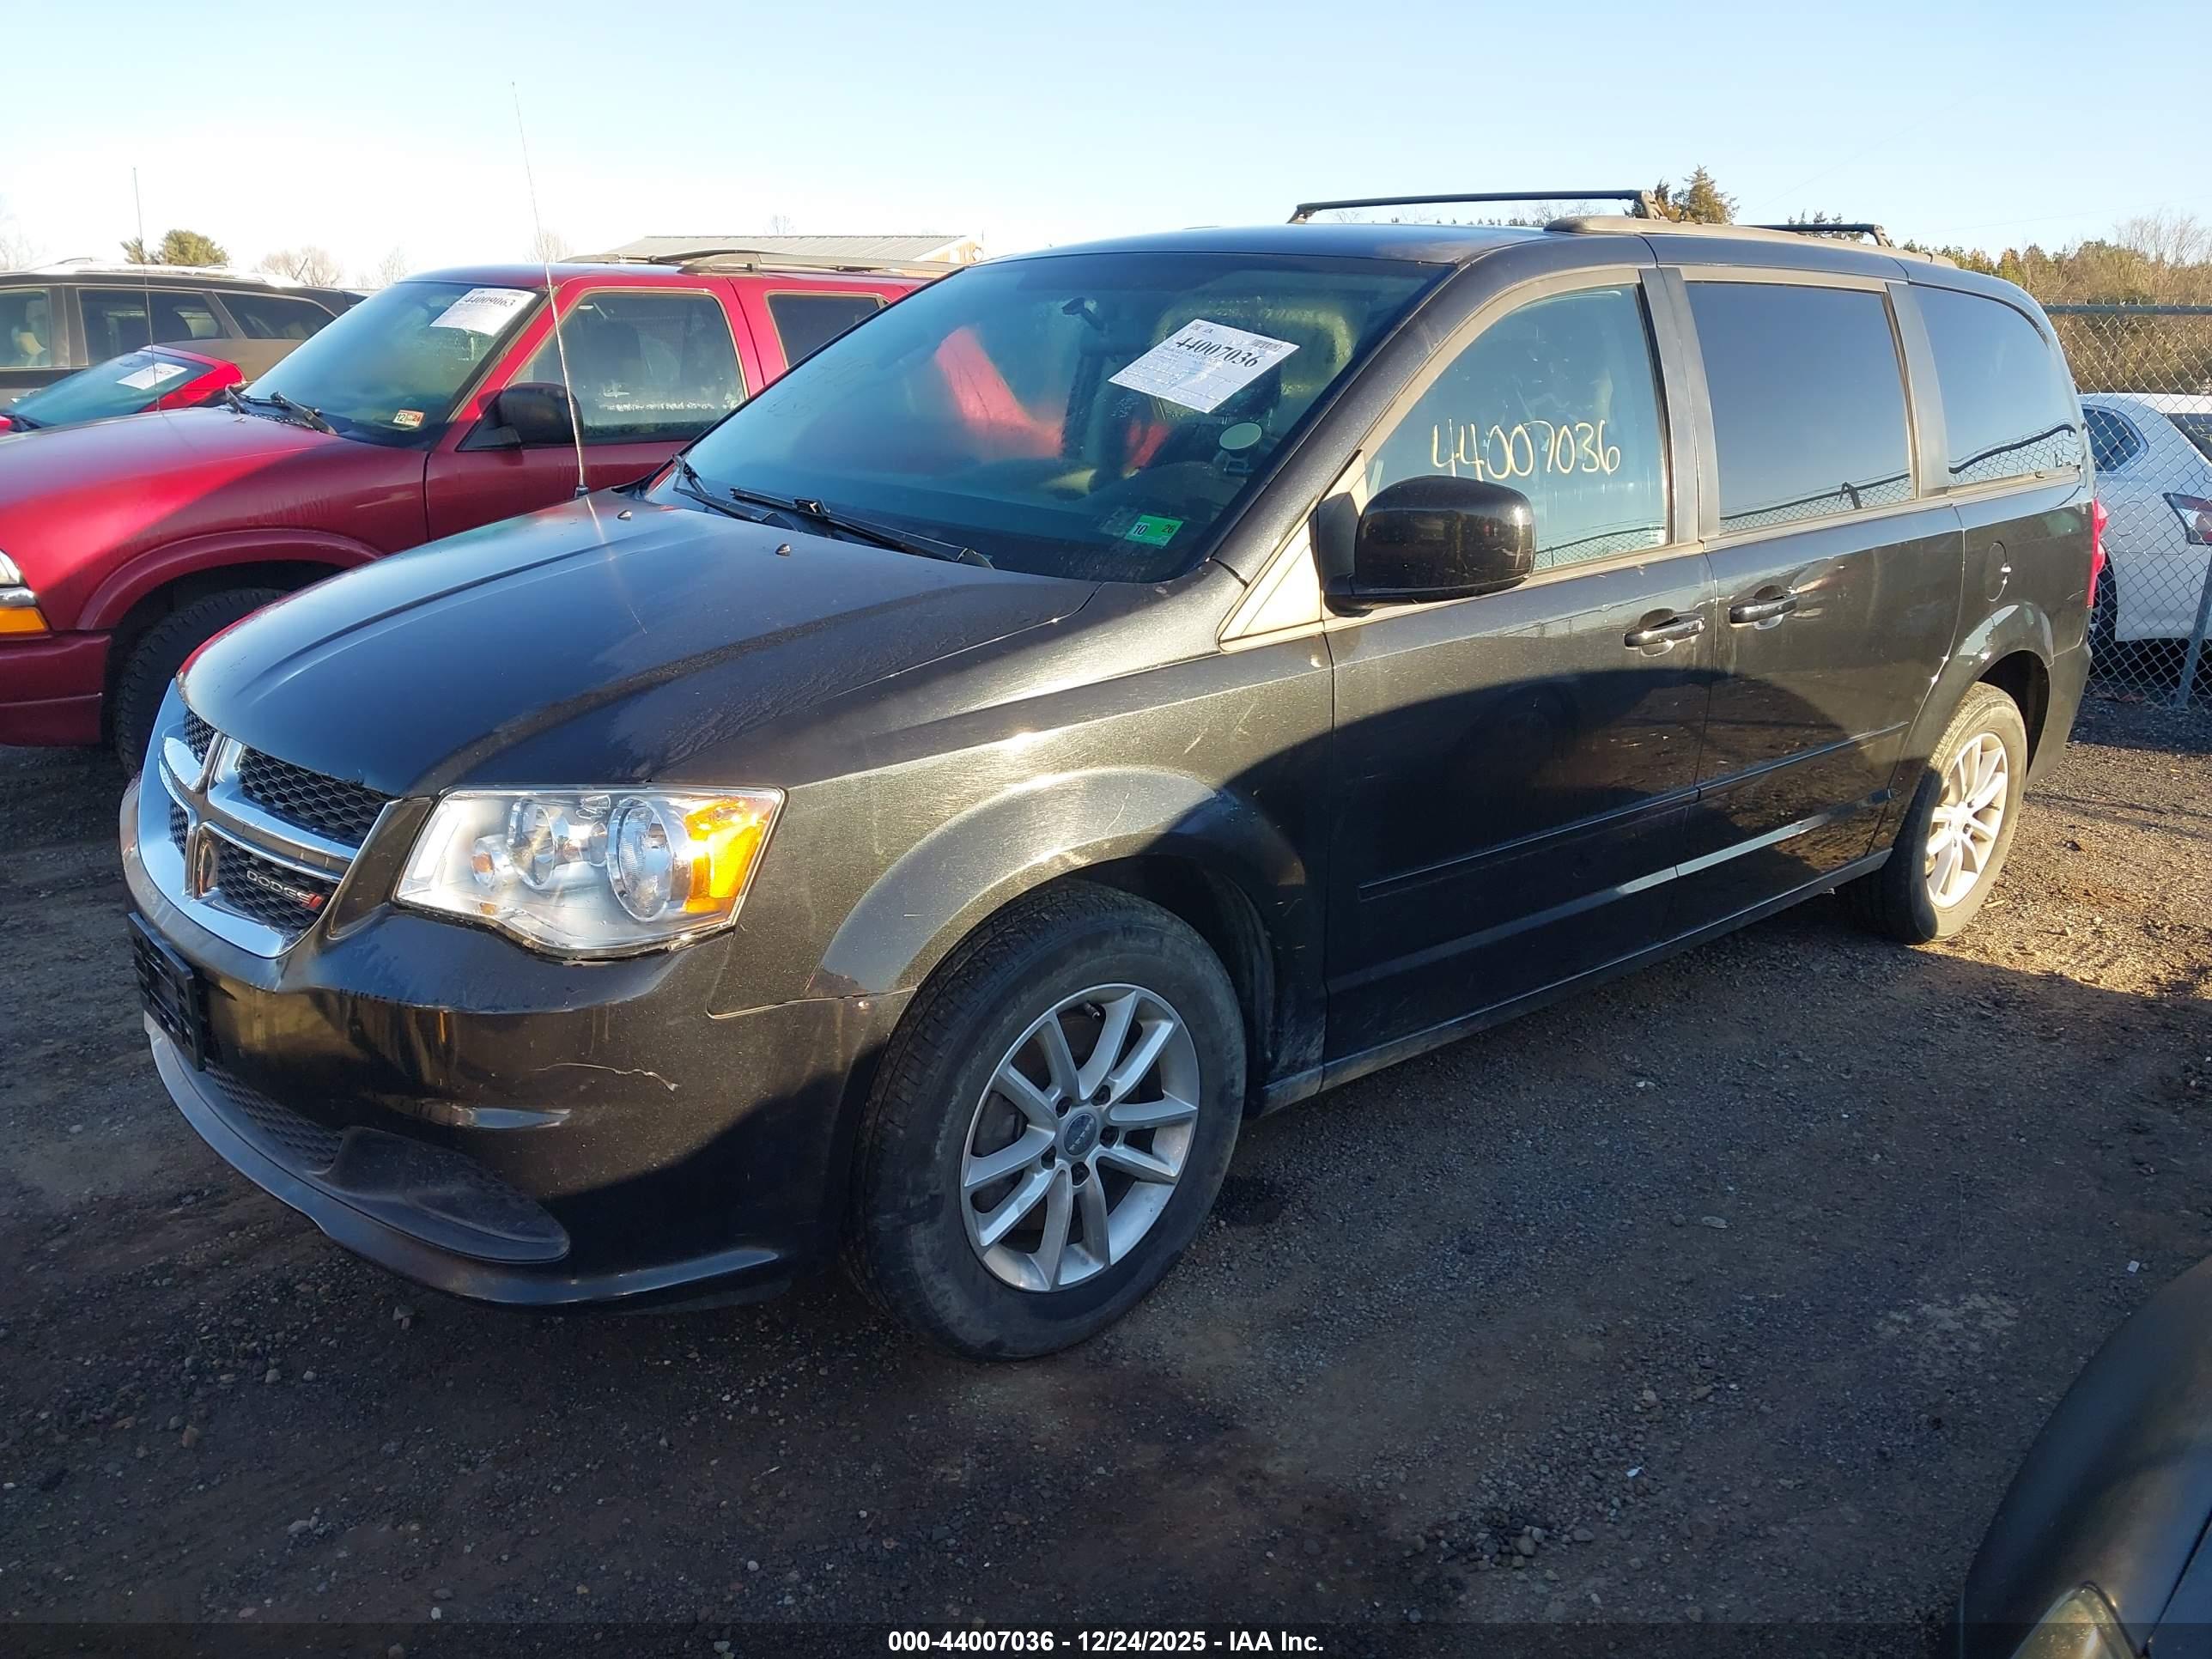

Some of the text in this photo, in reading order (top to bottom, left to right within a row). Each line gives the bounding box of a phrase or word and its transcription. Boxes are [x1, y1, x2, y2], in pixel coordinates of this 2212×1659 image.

[1175, 336, 1263, 368] 44007036
[1432, 418, 1621, 482] 44007036
[1133, 523, 1176, 536] 10 26
[246, 870, 310, 905] DODGE
